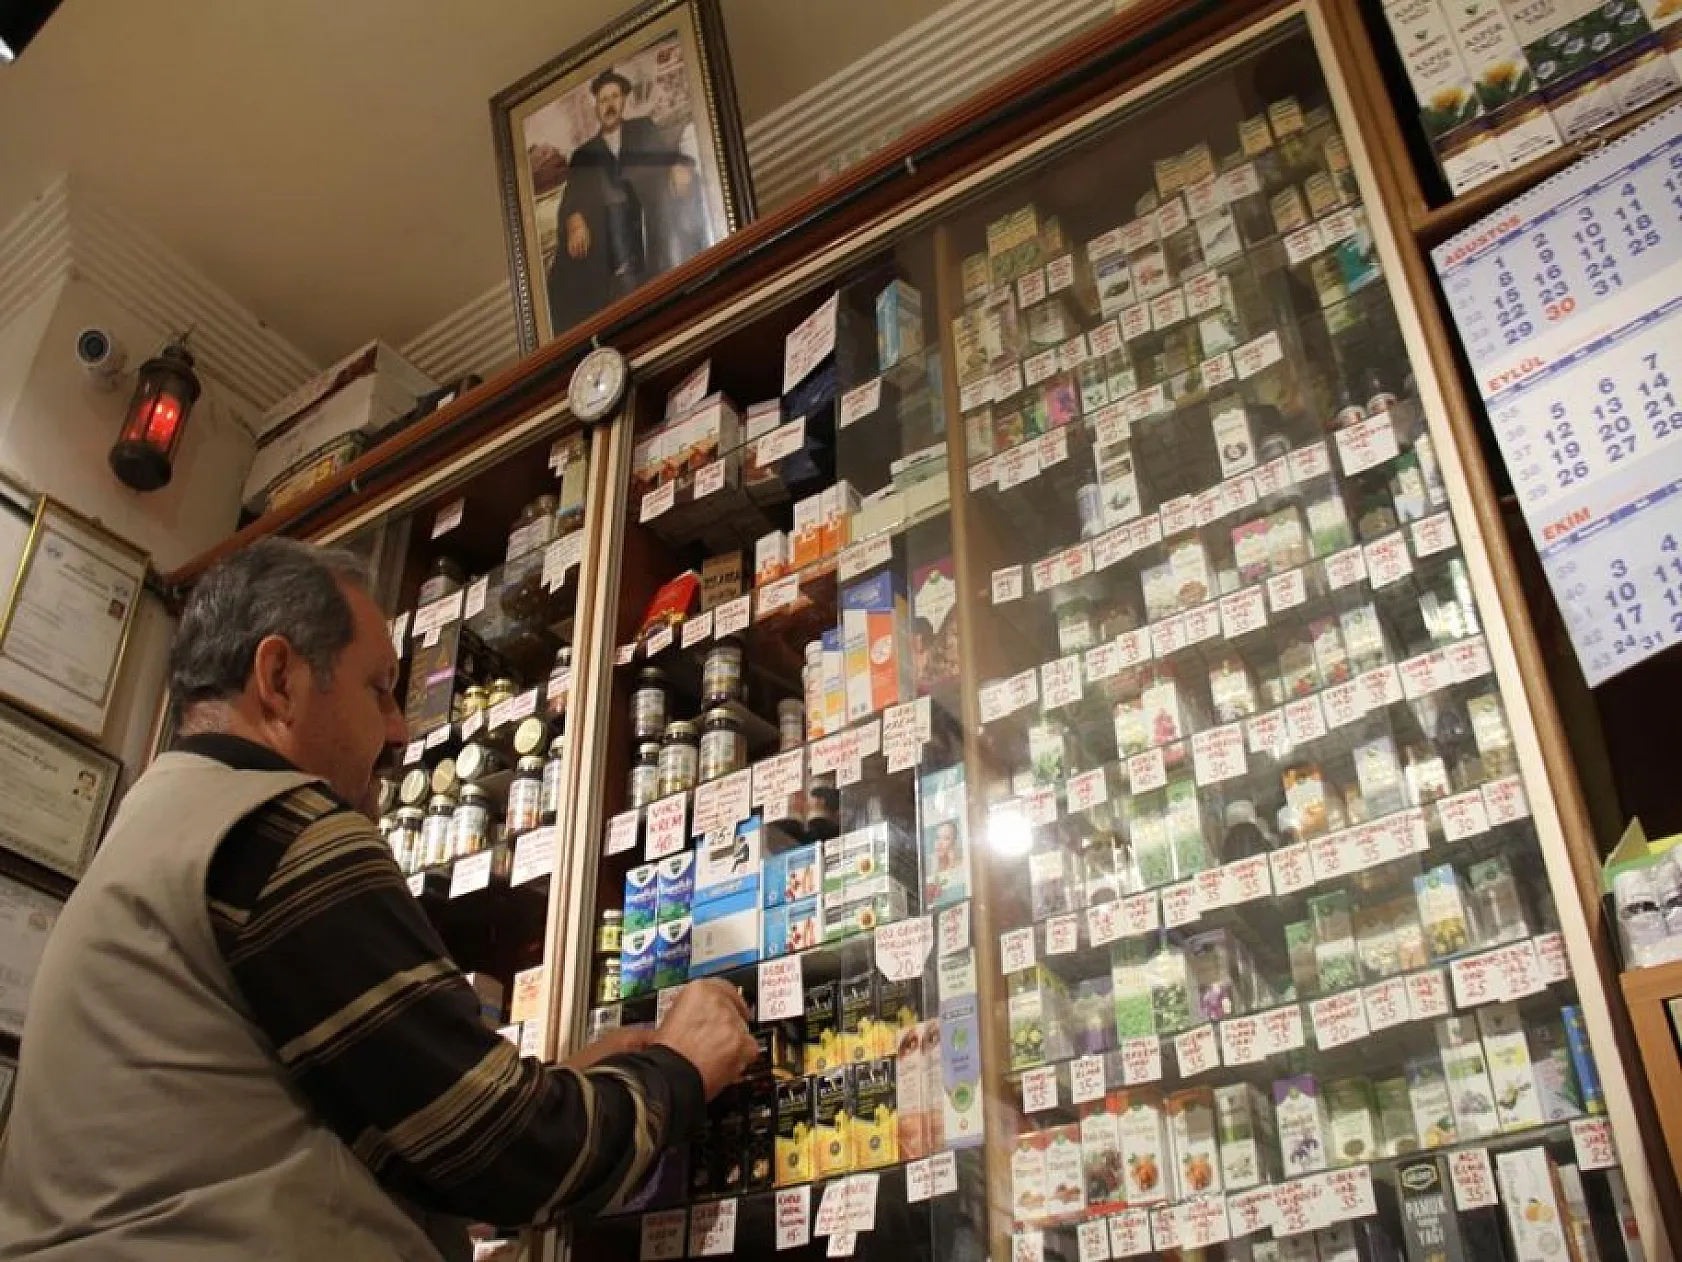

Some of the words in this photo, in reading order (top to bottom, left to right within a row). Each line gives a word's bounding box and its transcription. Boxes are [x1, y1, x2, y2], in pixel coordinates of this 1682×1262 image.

[1573, 223, 1601, 244] 10
[1534, 264, 1562, 286] 16
[1579, 236, 1607, 261] 17
[1538, 281, 1569, 305] 23
[1585, 254, 1616, 279] 24
[1628, 229, 1660, 257] 25
[1504, 321, 1533, 345] 29
[1545, 296, 1576, 321] 30
[1593, 272, 1623, 296] 31
[1544, 422, 1575, 446] 12
[1591, 397, 1623, 421] 13
[1637, 371, 1669, 397] 14
[1550, 402, 1565, 419] 5
[1599, 376, 1615, 394] 6
[1641, 352, 1657, 371] 7
[1552, 440, 1580, 465] 19
[1599, 416, 1631, 443] 20
[1643, 392, 1676, 419] 21
[1556, 461, 1589, 488] 26
[1606, 434, 1637, 462] 27
[1610, 558, 1628, 578] 3
[1660, 533, 1679, 552] 4
[1604, 582, 1637, 609] 10
[1614, 603, 1641, 630] 17
